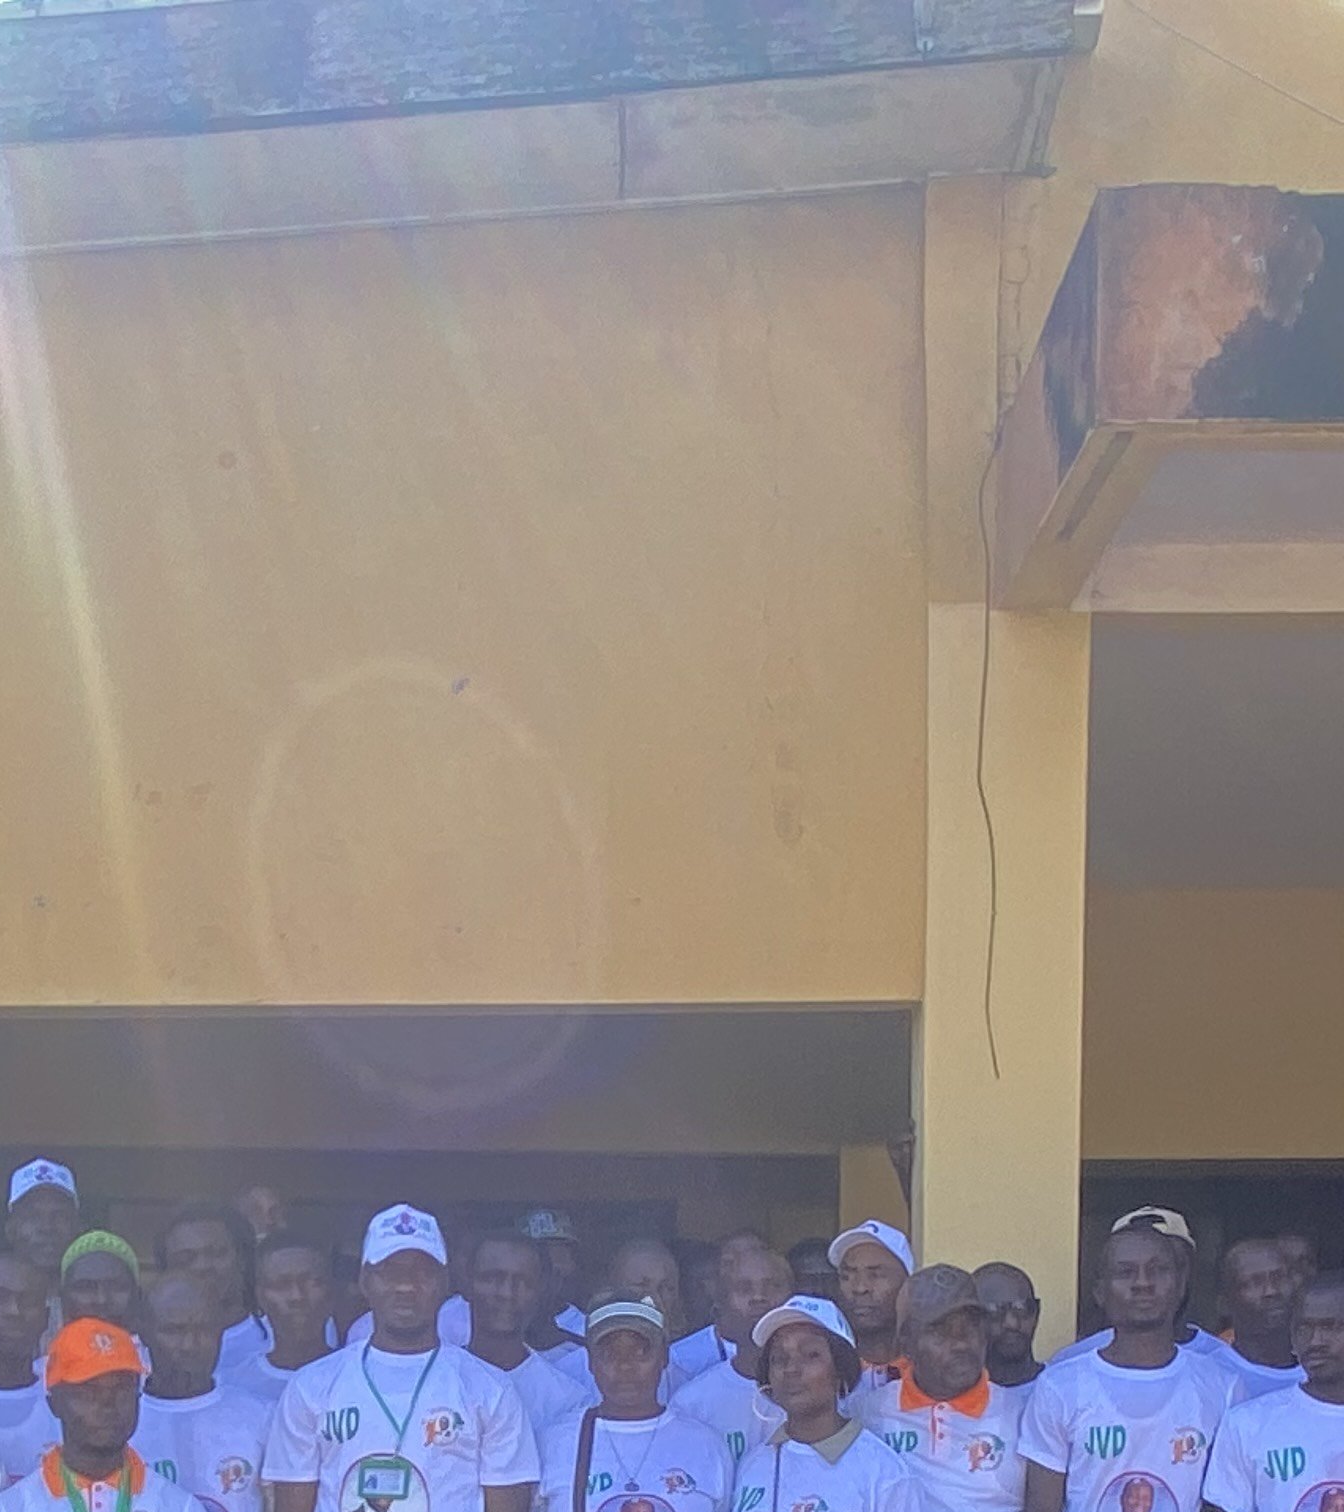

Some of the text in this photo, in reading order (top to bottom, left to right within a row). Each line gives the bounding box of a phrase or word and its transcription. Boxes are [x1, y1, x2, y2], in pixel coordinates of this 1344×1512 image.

[321, 1406, 360, 1444] JVD
[1084, 1425, 1126, 1460] JVD
[1263, 1446, 1306, 1482] JVD
